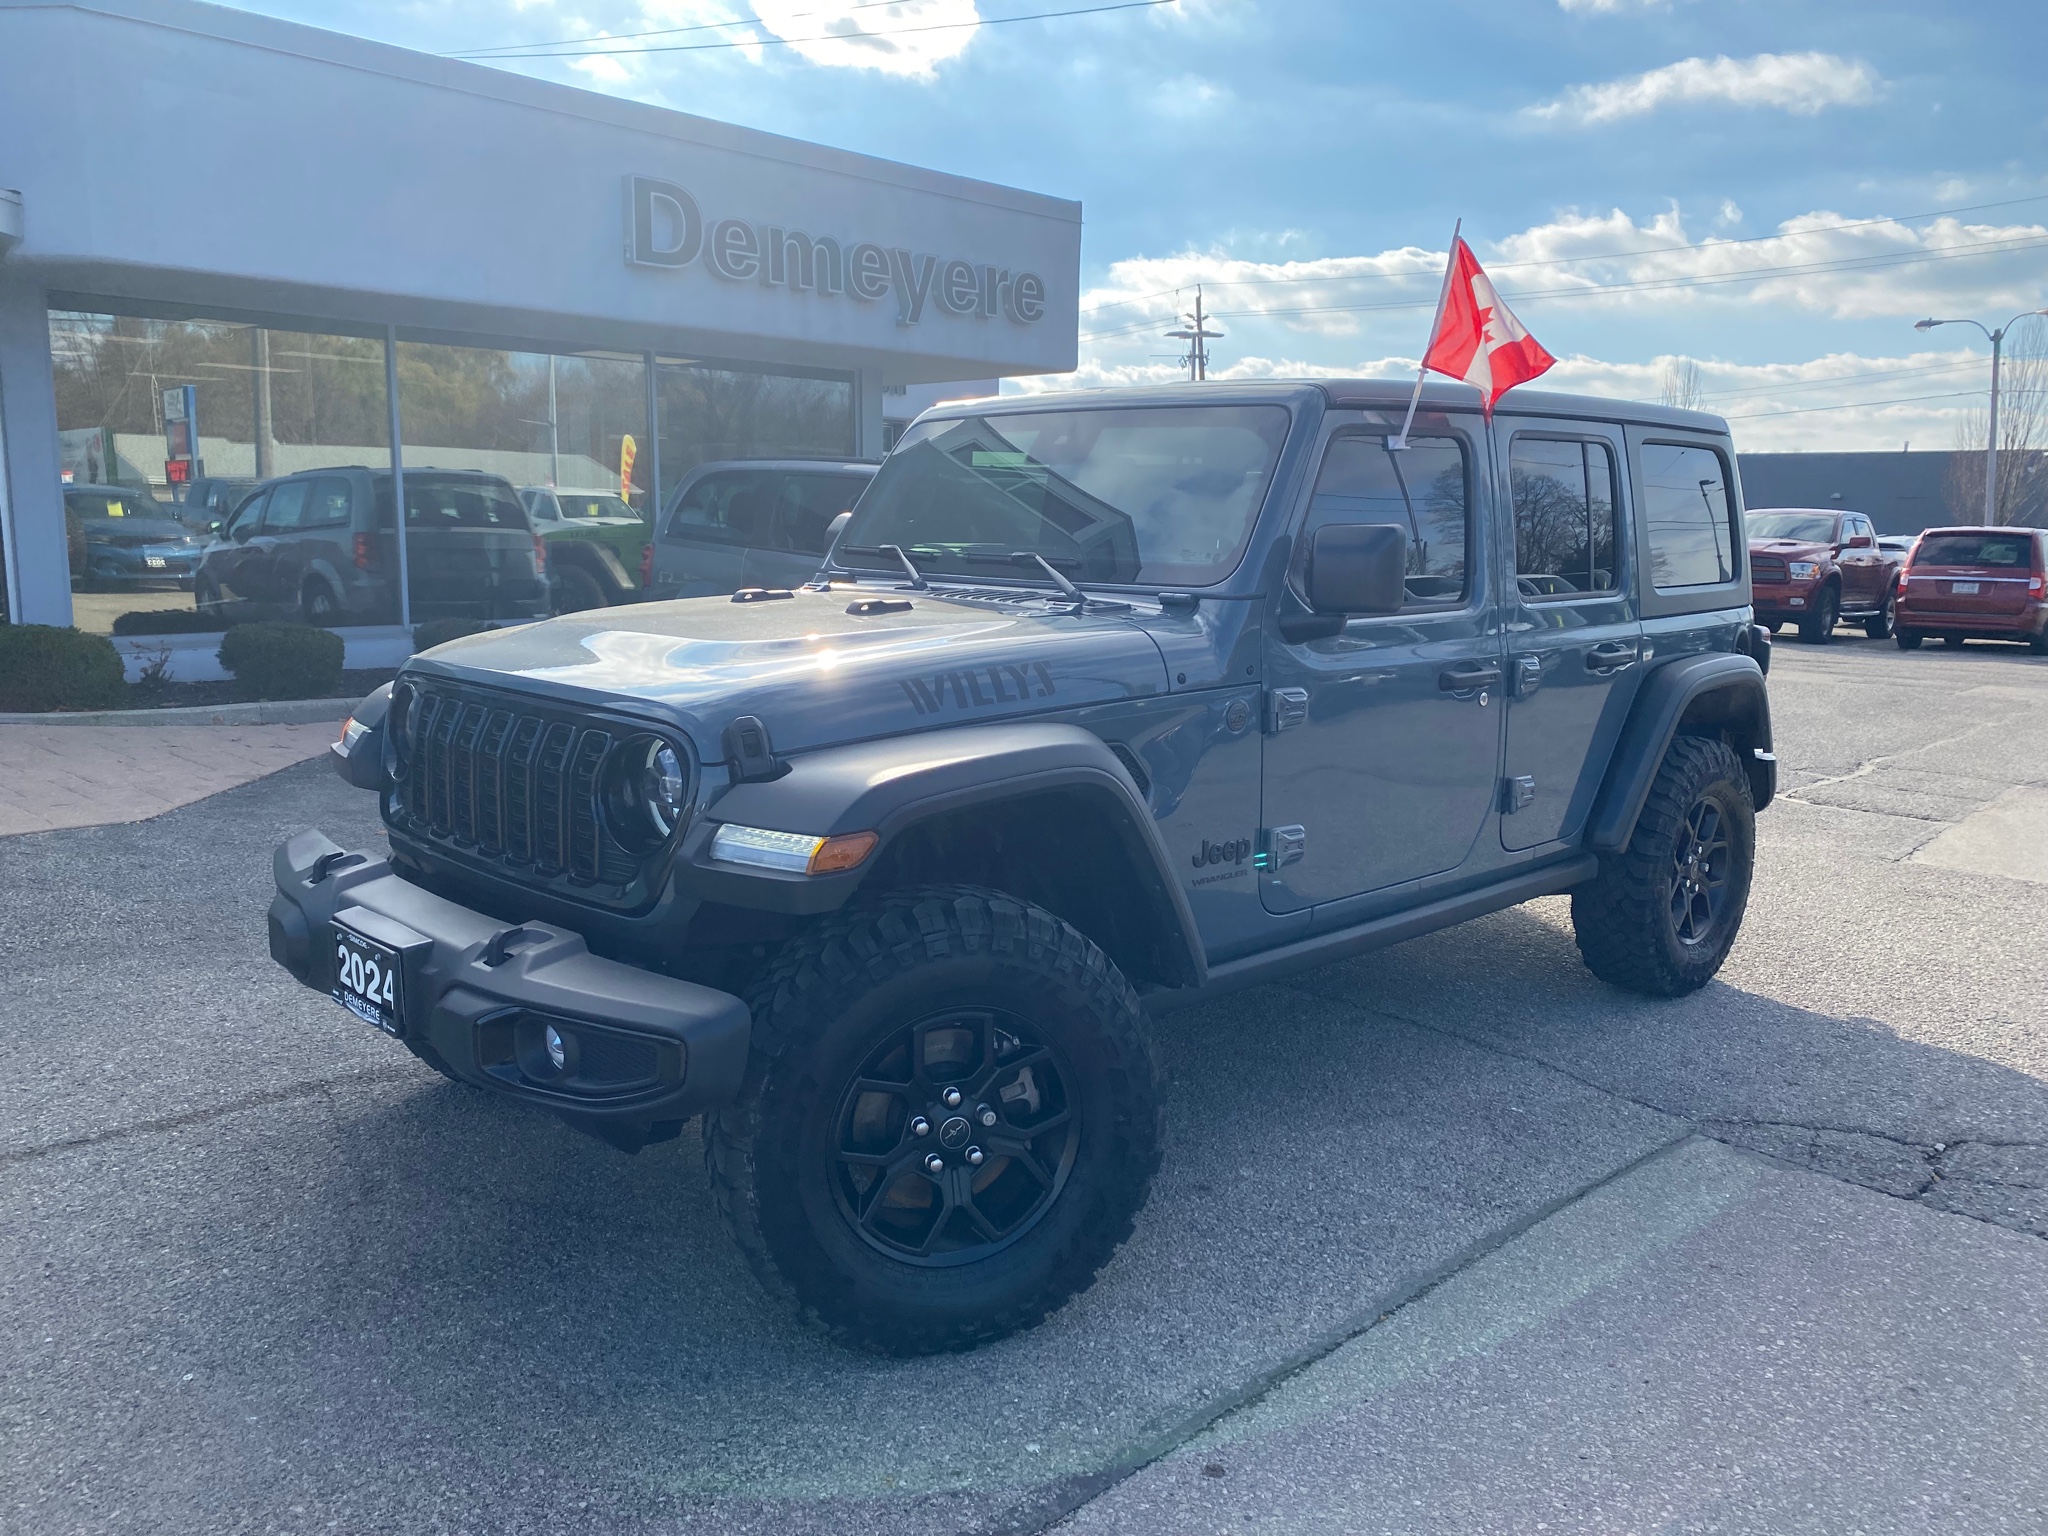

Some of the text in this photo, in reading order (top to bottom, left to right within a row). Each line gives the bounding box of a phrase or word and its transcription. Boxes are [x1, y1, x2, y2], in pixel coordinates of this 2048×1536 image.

[622, 173, 1047, 326] Demeyere
[898, 660, 1056, 715] WILLYS
[1192, 838, 1251, 868] Jeep
[1192, 869, 1248, 887] WRANGLER
[338, 944, 394, 1010] 2024
[344, 991, 380, 1020] DEMEYERE
